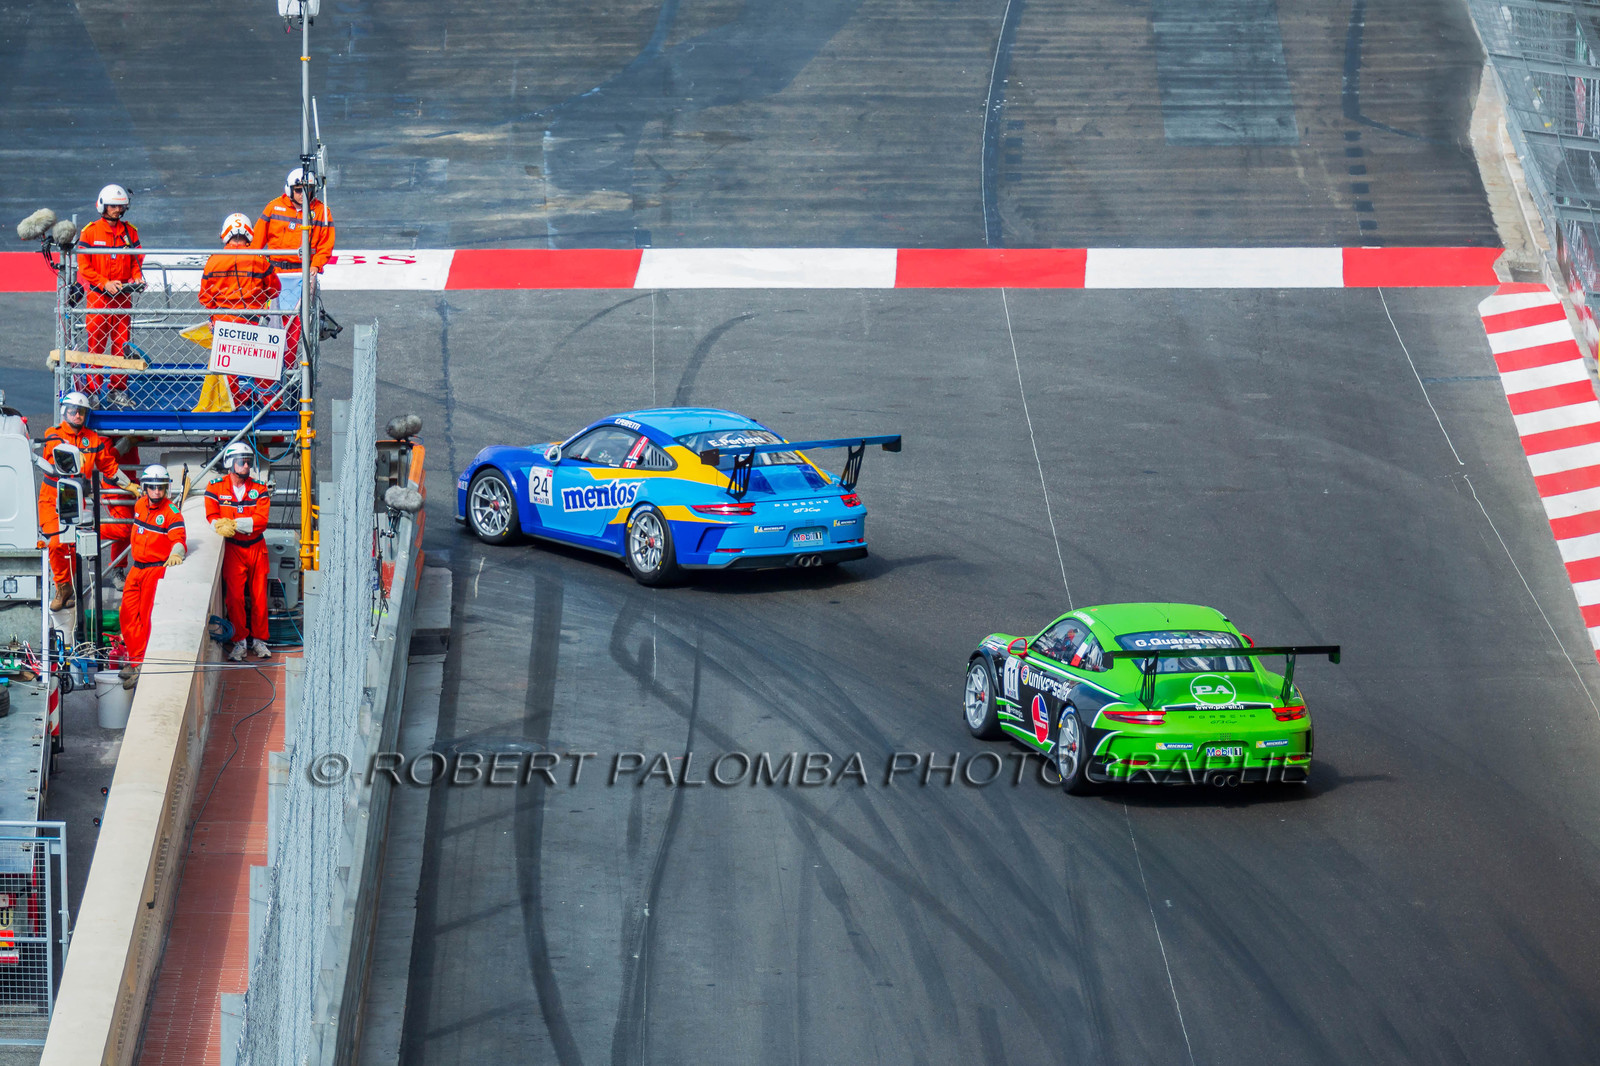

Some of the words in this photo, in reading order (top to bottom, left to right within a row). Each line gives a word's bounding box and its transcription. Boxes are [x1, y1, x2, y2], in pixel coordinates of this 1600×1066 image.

[218, 328, 259, 342] SECTEUR
[268, 334, 280, 345] 10
[218, 343, 277, 360] INTERVENTION
[217, 354, 231, 368] 10
[533, 475, 549, 497] 24
[561, 480, 641, 512] mentos
[774, 500, 829, 508] PORSCHE
[792, 532, 814, 542] Mobil
[1135, 637, 1231, 647] G.Quaresmini
[1193, 685, 1233, 695] PA
[1206, 747, 1233, 757] Mobil
